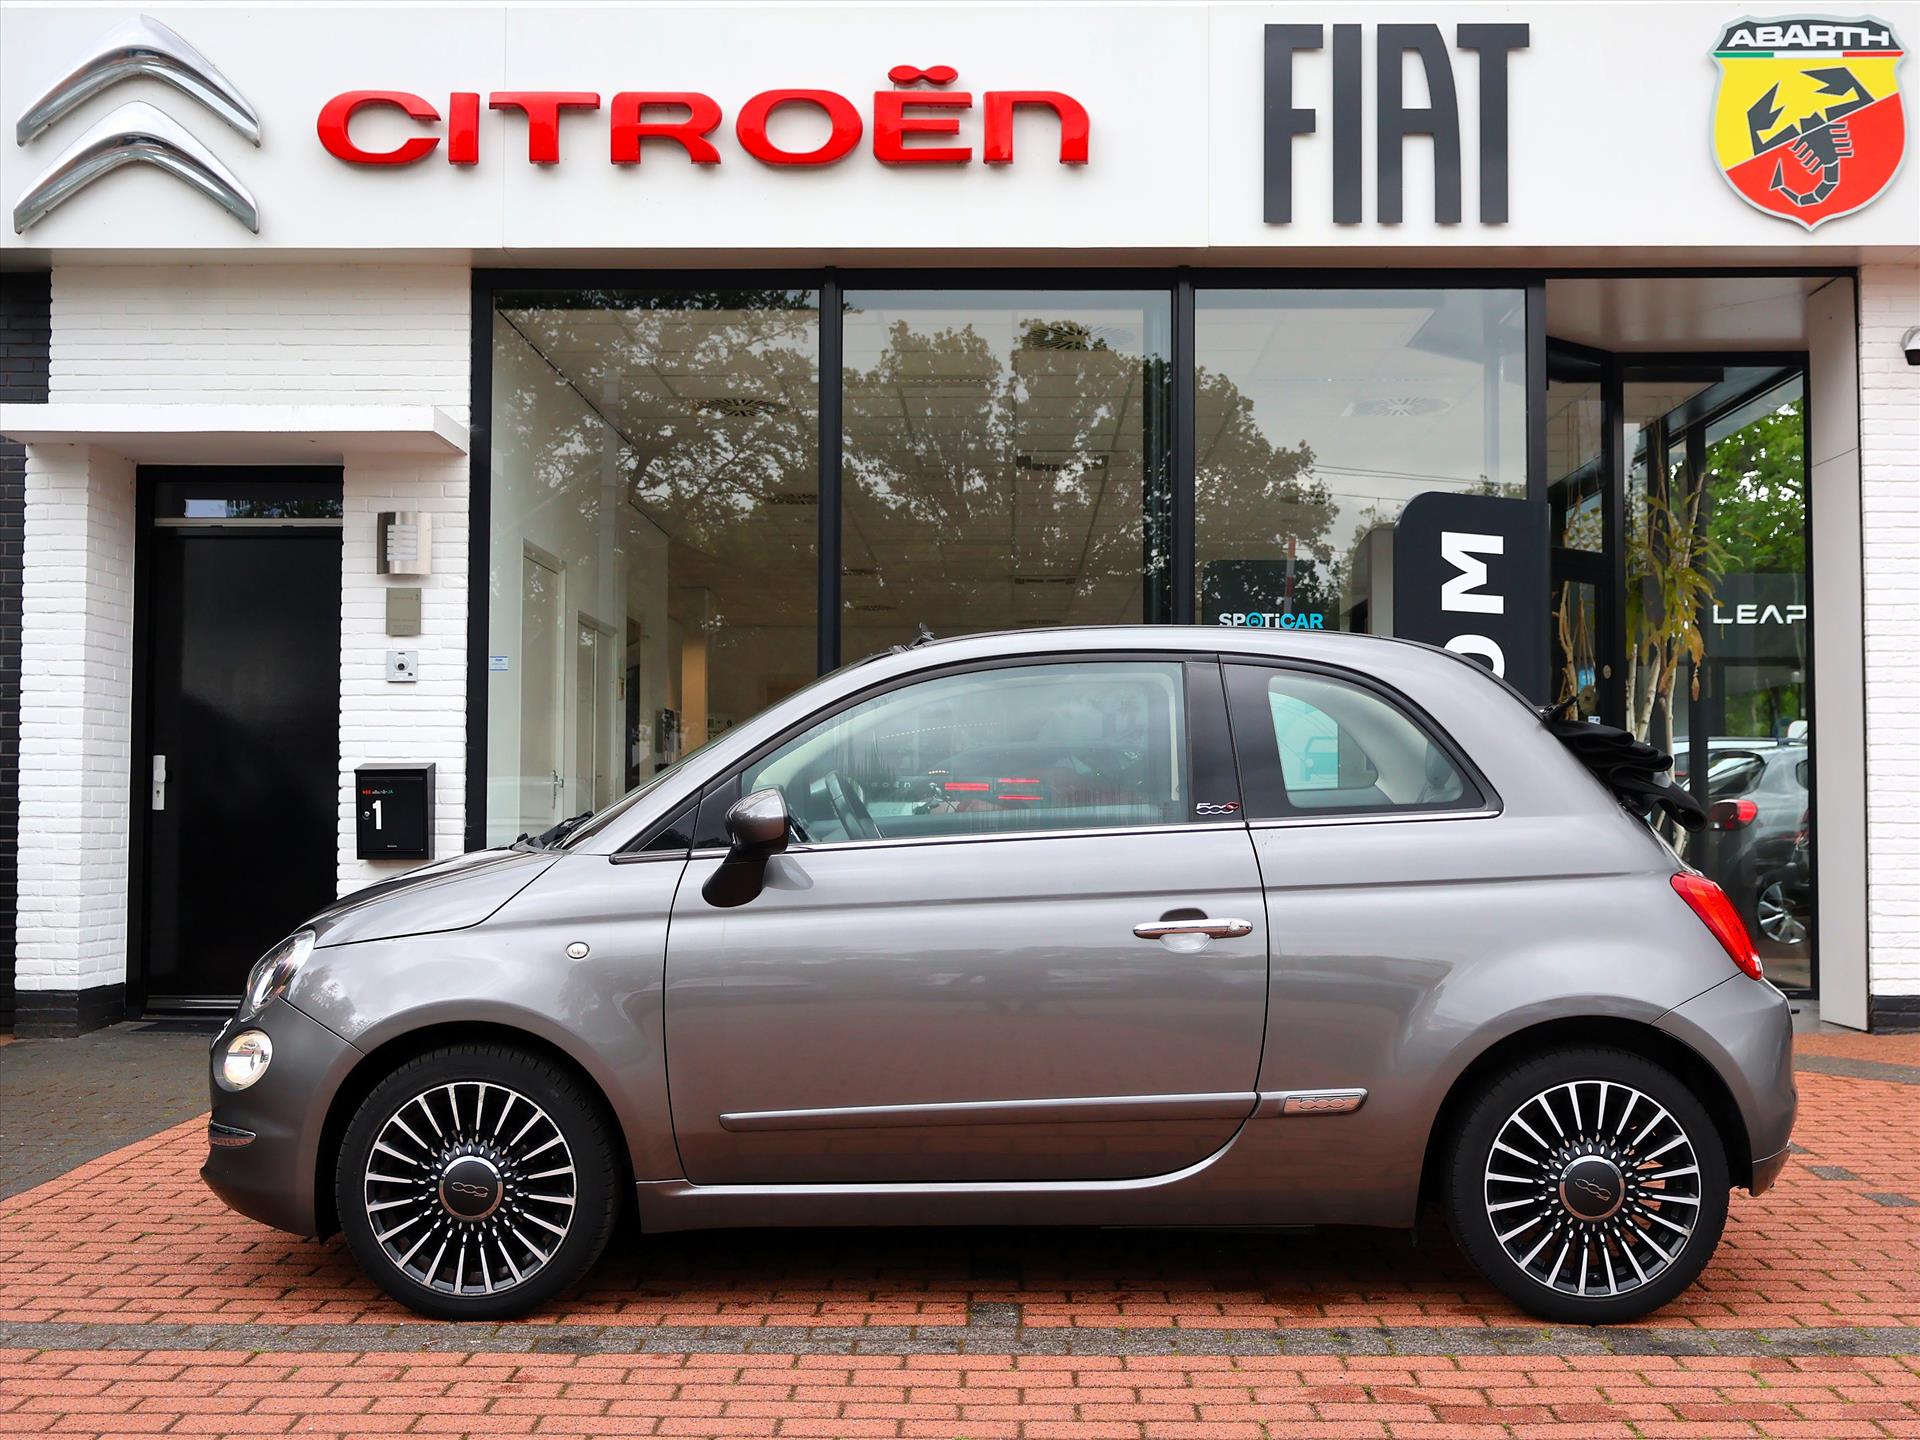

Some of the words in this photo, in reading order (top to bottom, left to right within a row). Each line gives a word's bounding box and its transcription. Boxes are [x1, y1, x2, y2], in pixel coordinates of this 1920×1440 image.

[1727, 24, 1890, 48] ABARTH
[1264, 23, 1530, 224] FIAT
[1713, 604, 1807, 624] LEAP
[372, 800, 382, 829] 1
